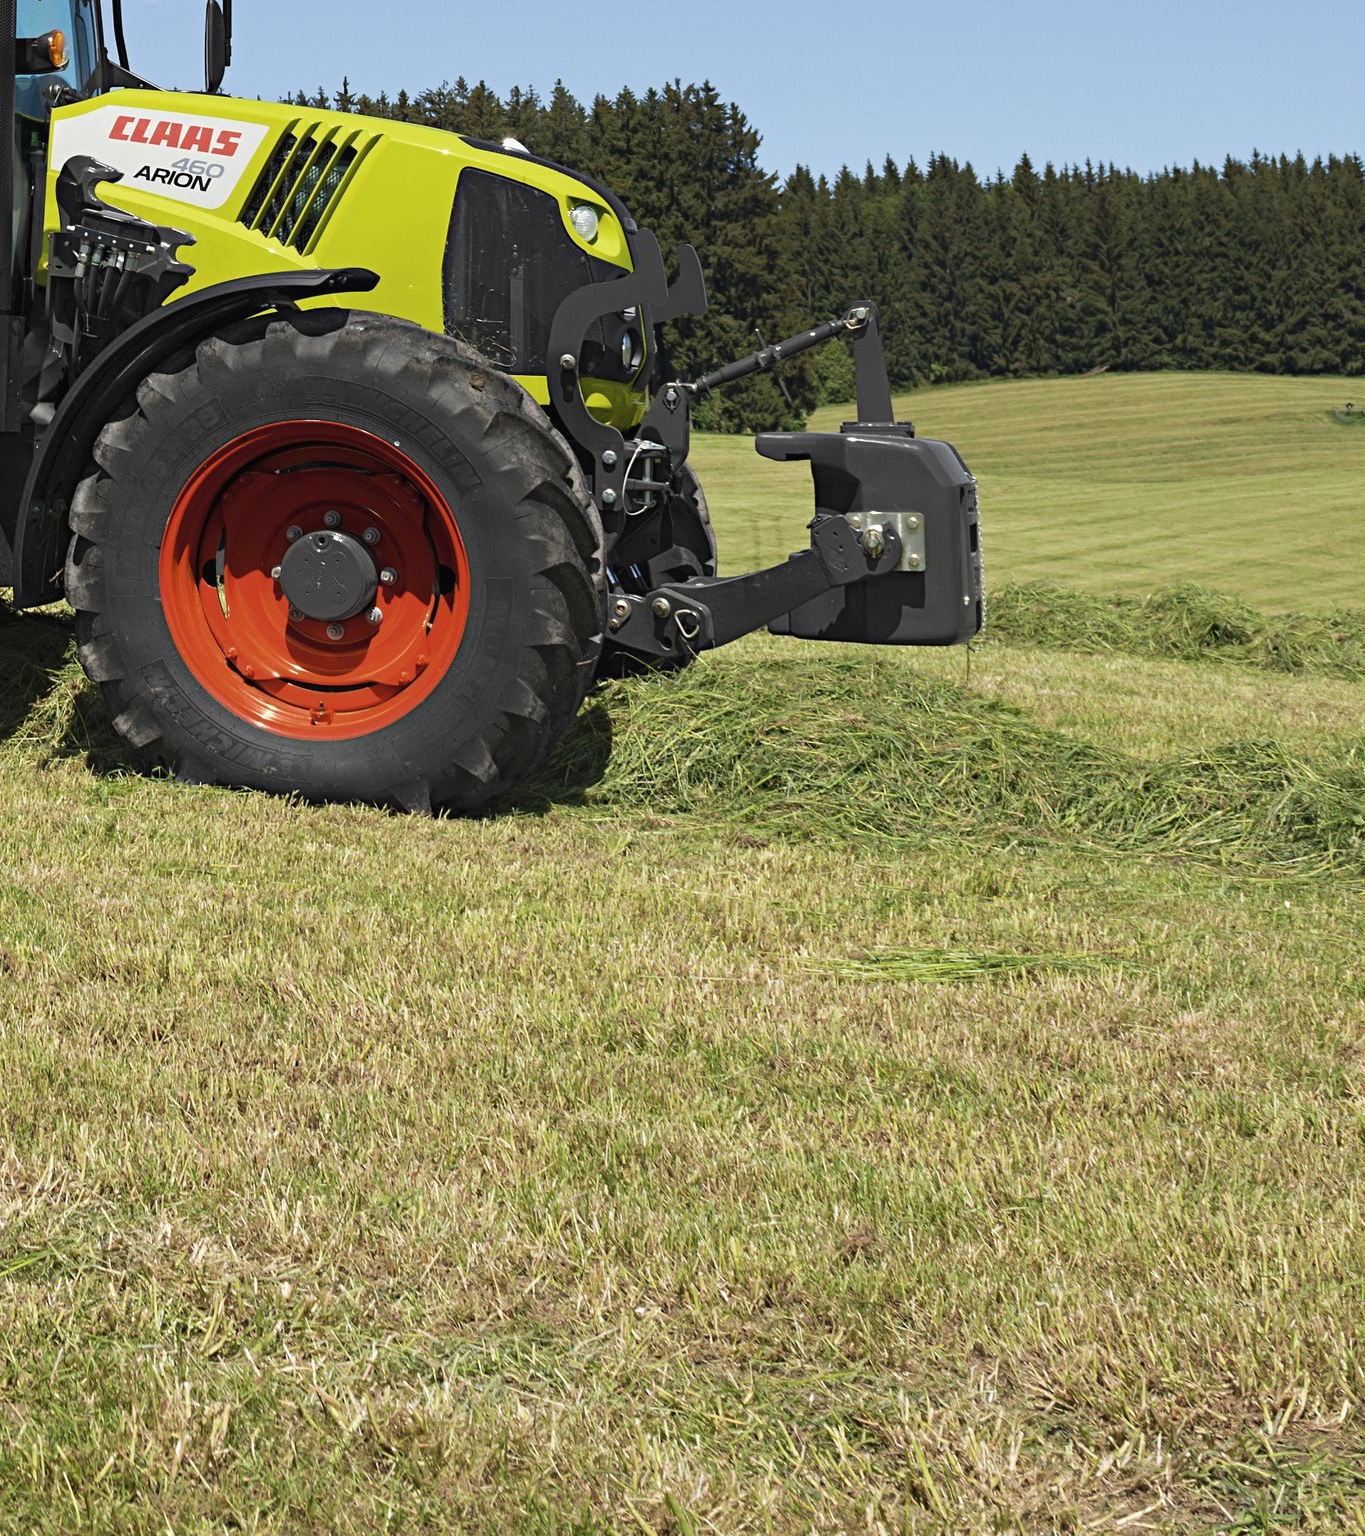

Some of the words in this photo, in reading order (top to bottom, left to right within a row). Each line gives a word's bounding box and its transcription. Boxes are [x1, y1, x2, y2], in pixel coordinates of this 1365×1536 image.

[108, 115, 243, 157] CLAAS
[133, 165, 212, 192] ARION
[171, 157, 225, 179] 460
[141, 665, 273, 769] MICHELIN
